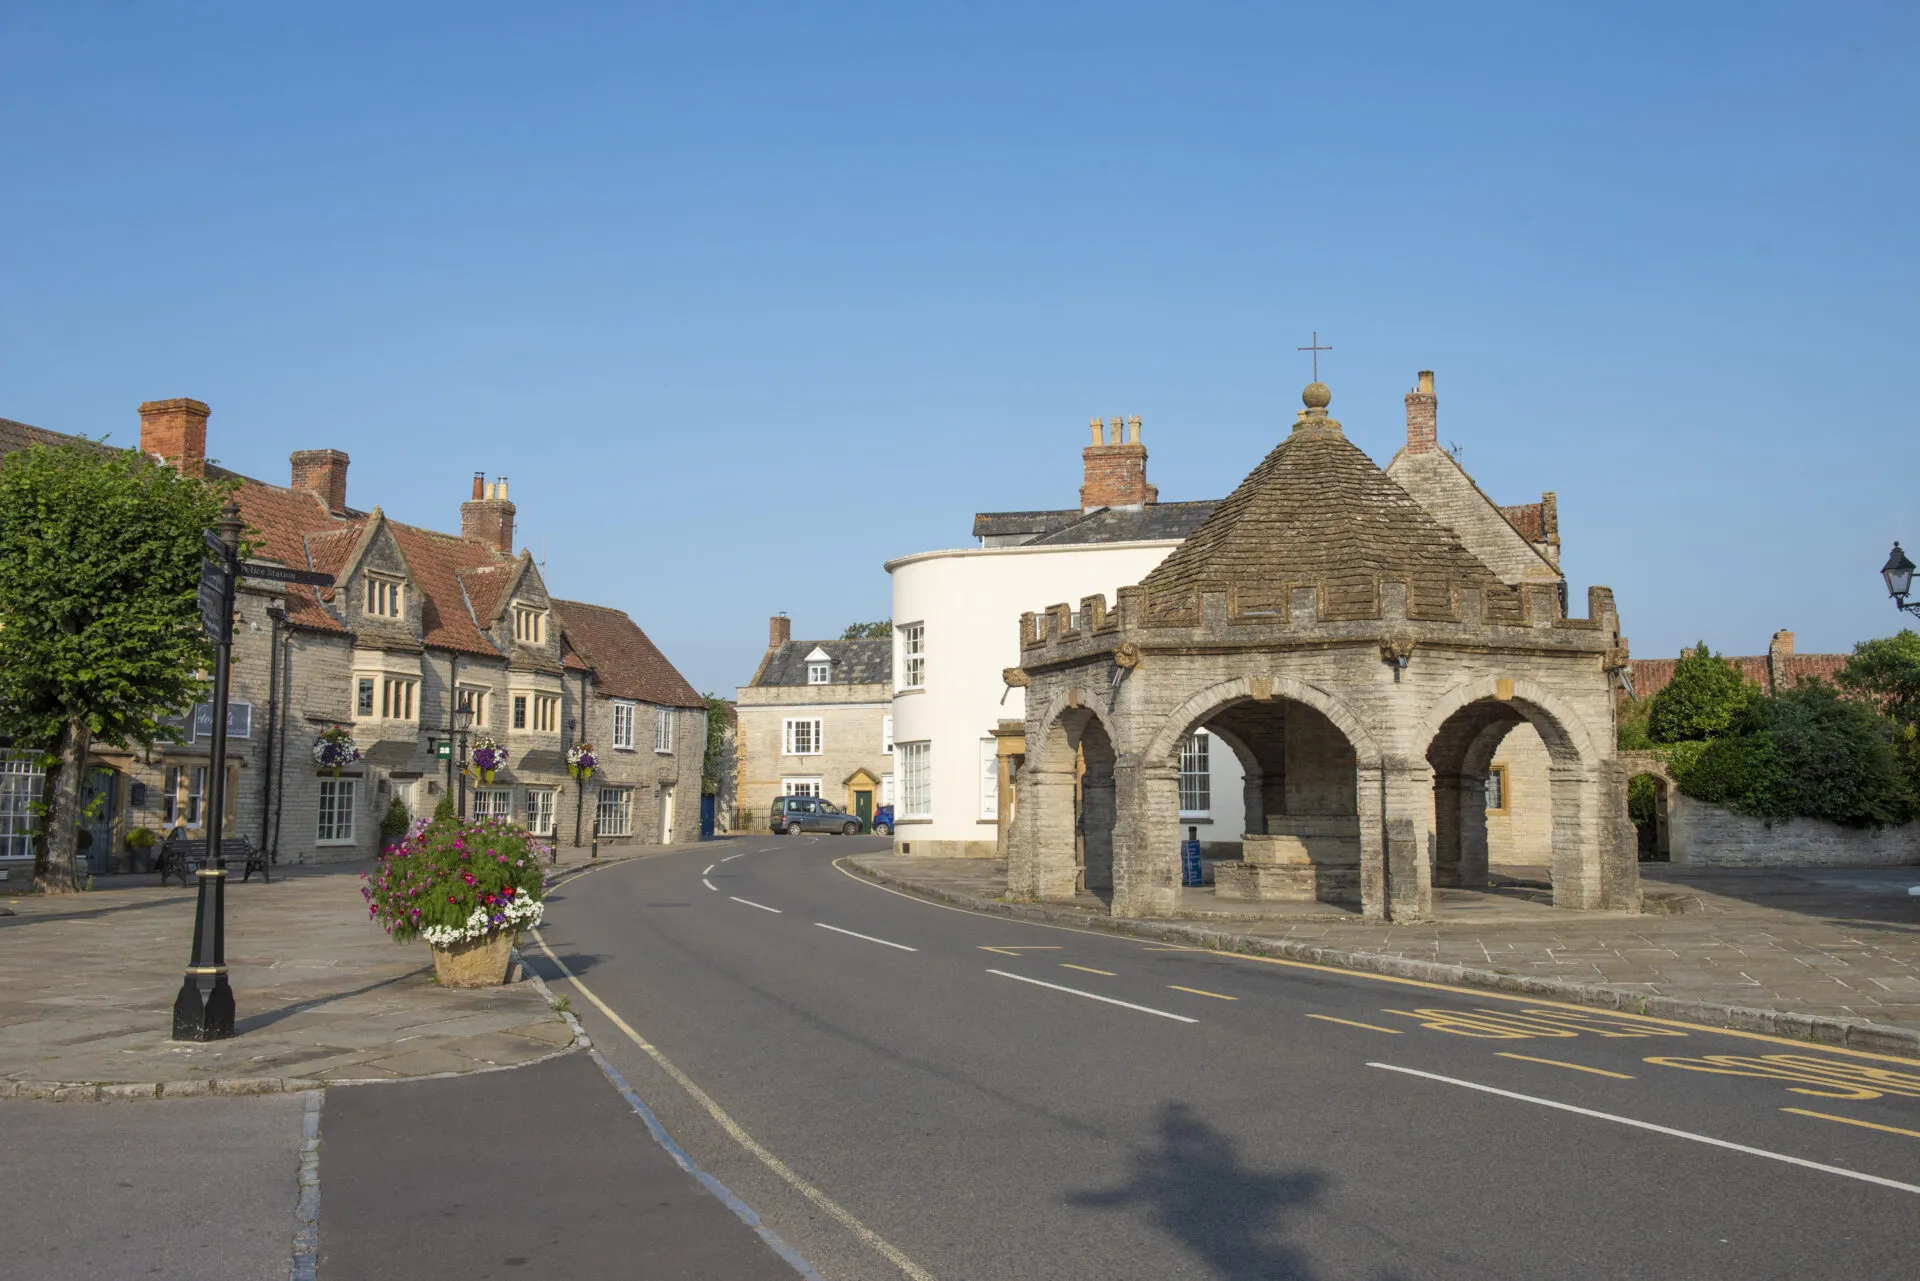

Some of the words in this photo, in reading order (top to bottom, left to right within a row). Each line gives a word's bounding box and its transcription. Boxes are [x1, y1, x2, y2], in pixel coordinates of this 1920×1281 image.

[240, 565, 266, 576] Police
[267, 567, 296, 579] Station
[1381, 1008, 1688, 1039] STOP
[1642, 1054, 1920, 1100] BUS
